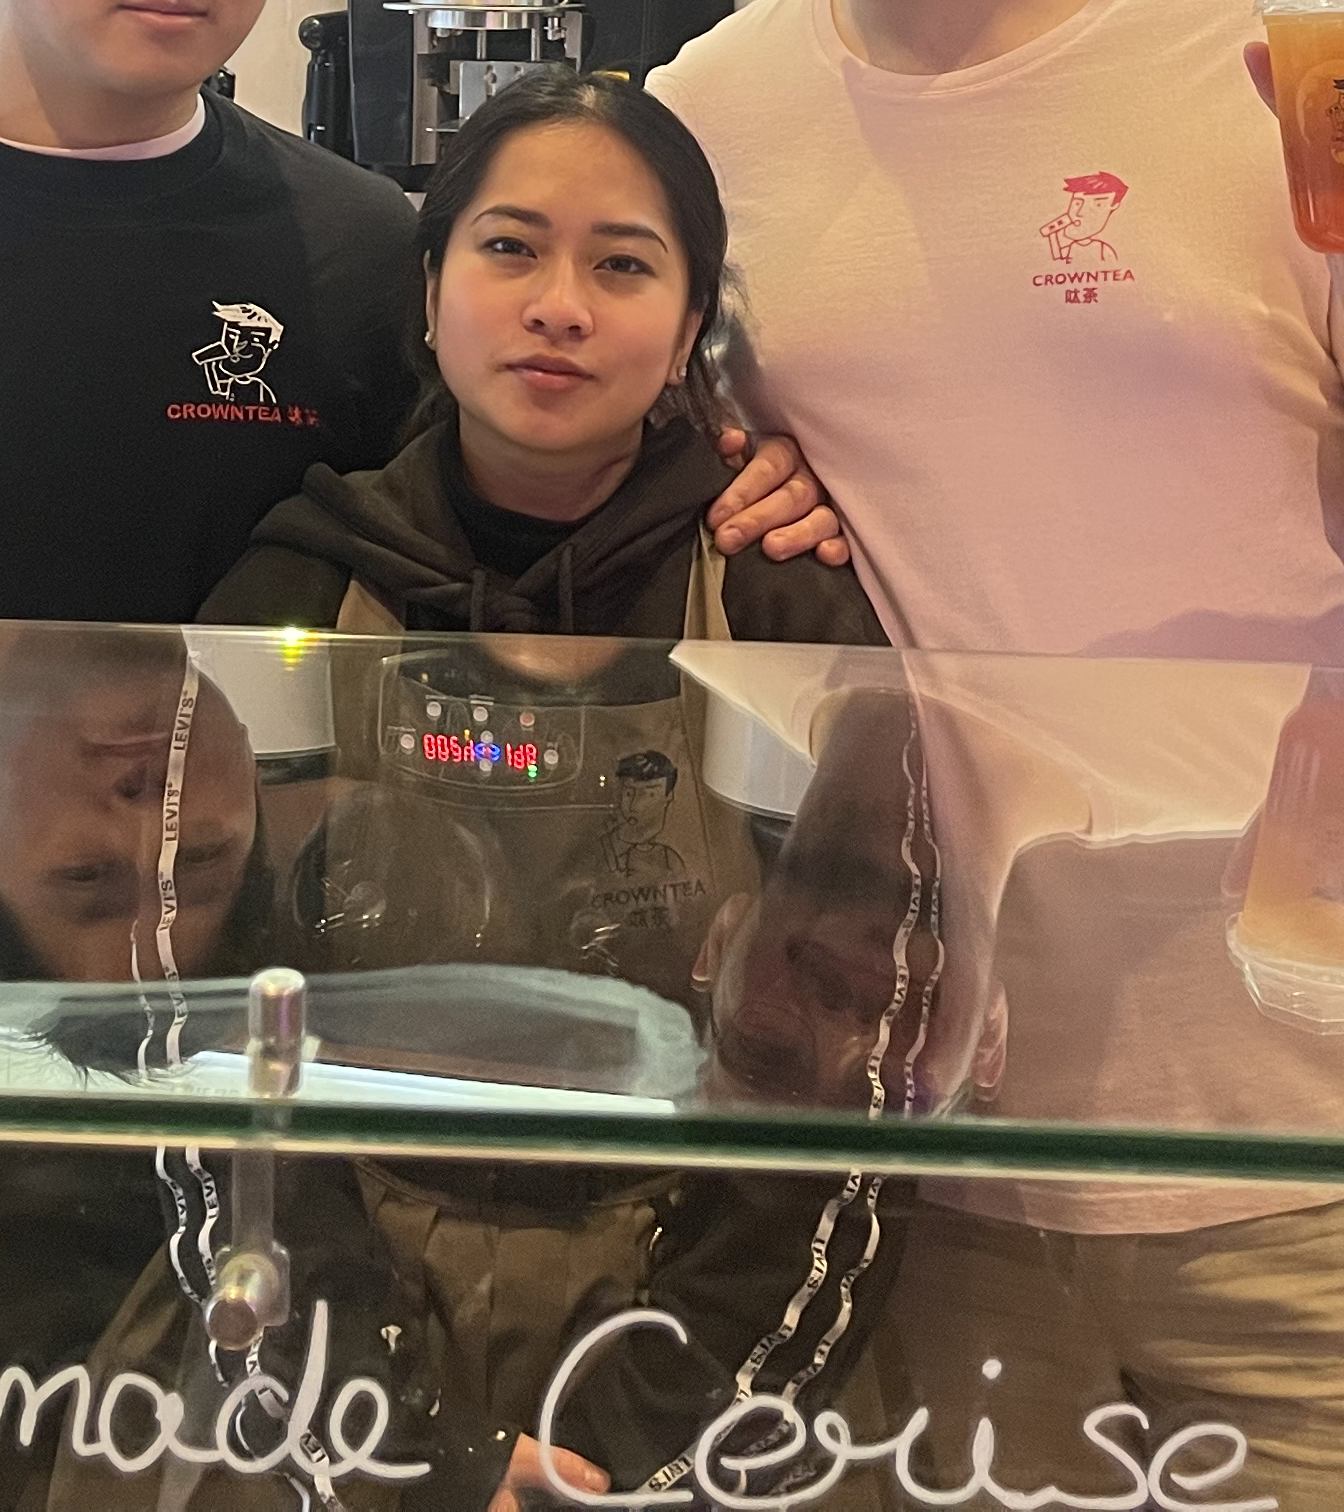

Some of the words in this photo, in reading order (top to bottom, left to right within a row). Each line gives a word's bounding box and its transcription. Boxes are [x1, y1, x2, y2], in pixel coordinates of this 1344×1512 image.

[1032, 269, 1135, 287] CROWNTEA
[167, 403, 281, 422] CROWNTEA
[592, 879, 707, 909] CROWNTEA
[538, 1308, 1278, 1510] Cerise
